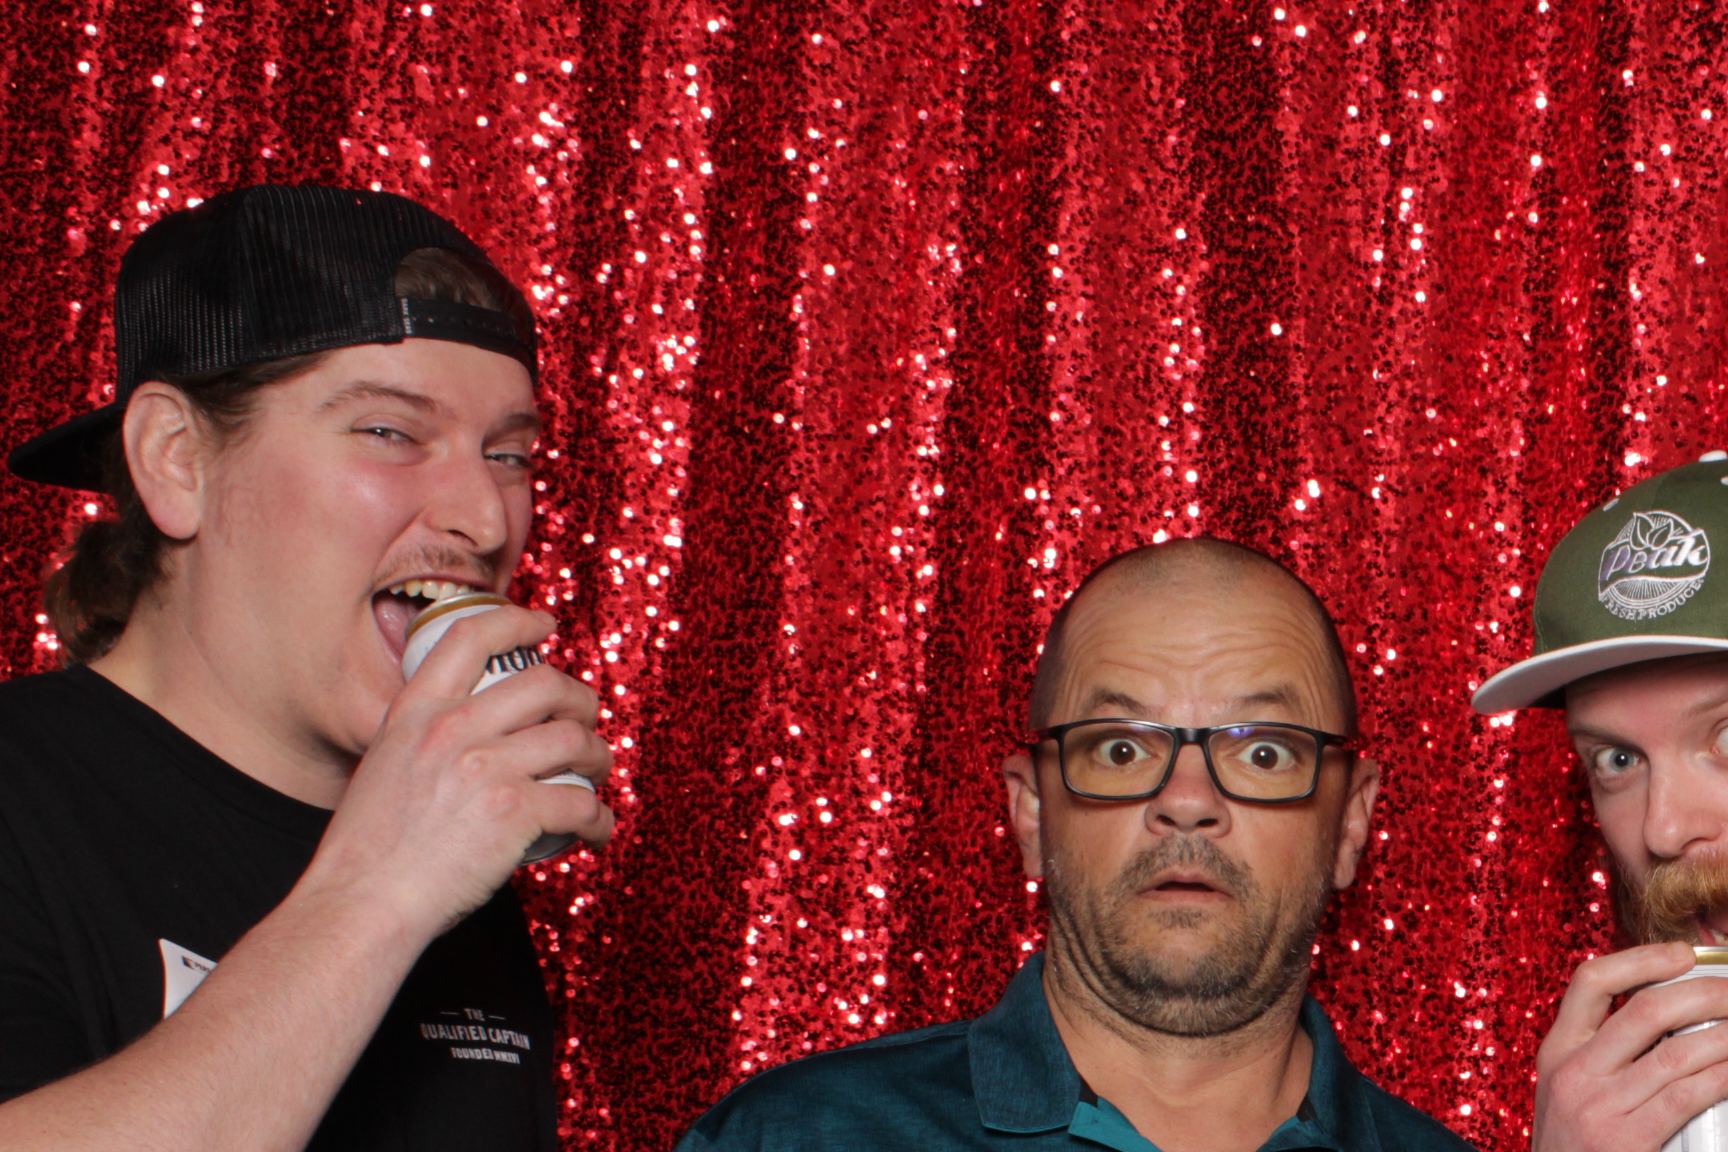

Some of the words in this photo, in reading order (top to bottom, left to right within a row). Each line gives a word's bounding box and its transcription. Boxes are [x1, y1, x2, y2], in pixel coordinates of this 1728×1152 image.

[1600, 536, 1709, 582] Peak
[1602, 597, 1637, 621] FRESH
[1637, 579, 1703, 621] PRODUCE
[463, 1007, 485, 1021] THE
[420, 1023, 488, 1040] QUALIFIED
[487, 1027, 531, 1050] CAPTAIN
[450, 1046, 495, 1060] FOUNDED
